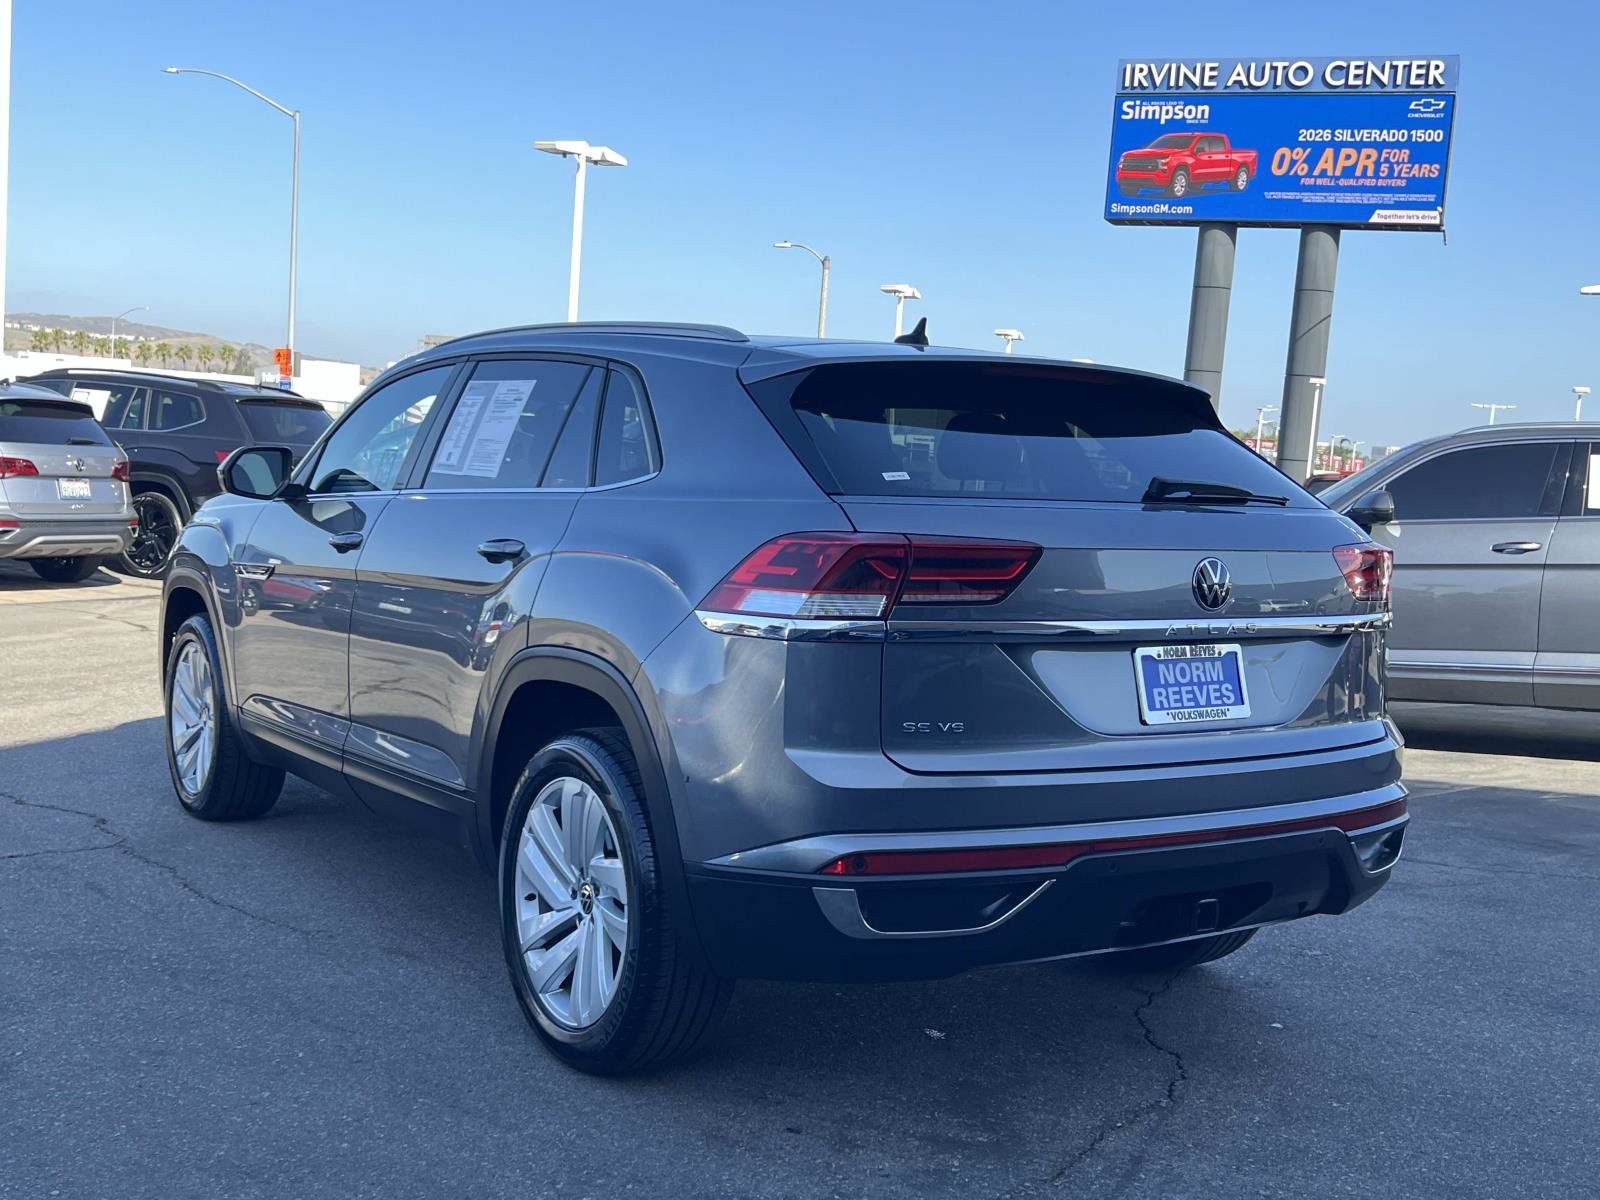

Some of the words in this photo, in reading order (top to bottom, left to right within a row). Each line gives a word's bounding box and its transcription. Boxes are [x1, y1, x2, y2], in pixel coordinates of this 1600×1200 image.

[1123, 62, 1219, 88] IRVINE
[1225, 61, 1314, 87] AUTO
[1323, 60, 1446, 86] CENTER
[1121, 100, 1210, 124] Simpson
[1298, 129, 1331, 142] 2026
[1334, 129, 1407, 142] SILVERADO
[1410, 130, 1444, 143] 1500
[1271, 147, 1311, 176] 0%
[1313, 148, 1378, 177] APR
[1380, 149, 1410, 162] FOR
[1379, 164, 1390, 177] 5
[1394, 164, 1440, 178] YEARS
[1300, 178, 1315, 186] FOR
[1377, 179, 1407, 187] BUYERS
[1110, 203, 1193, 215] SimpsonGM.com
[1165, 623, 1257, 636] ATLAS
[1162, 647, 1188, 658] NORM
[1190, 645, 1216, 657] REEVES
[1158, 661, 1224, 684] NORM
[1152, 683, 1235, 709] REEVES
[1170, 708, 1228, 721] VOLKSWAGEN
[903, 722, 930, 732] SE
